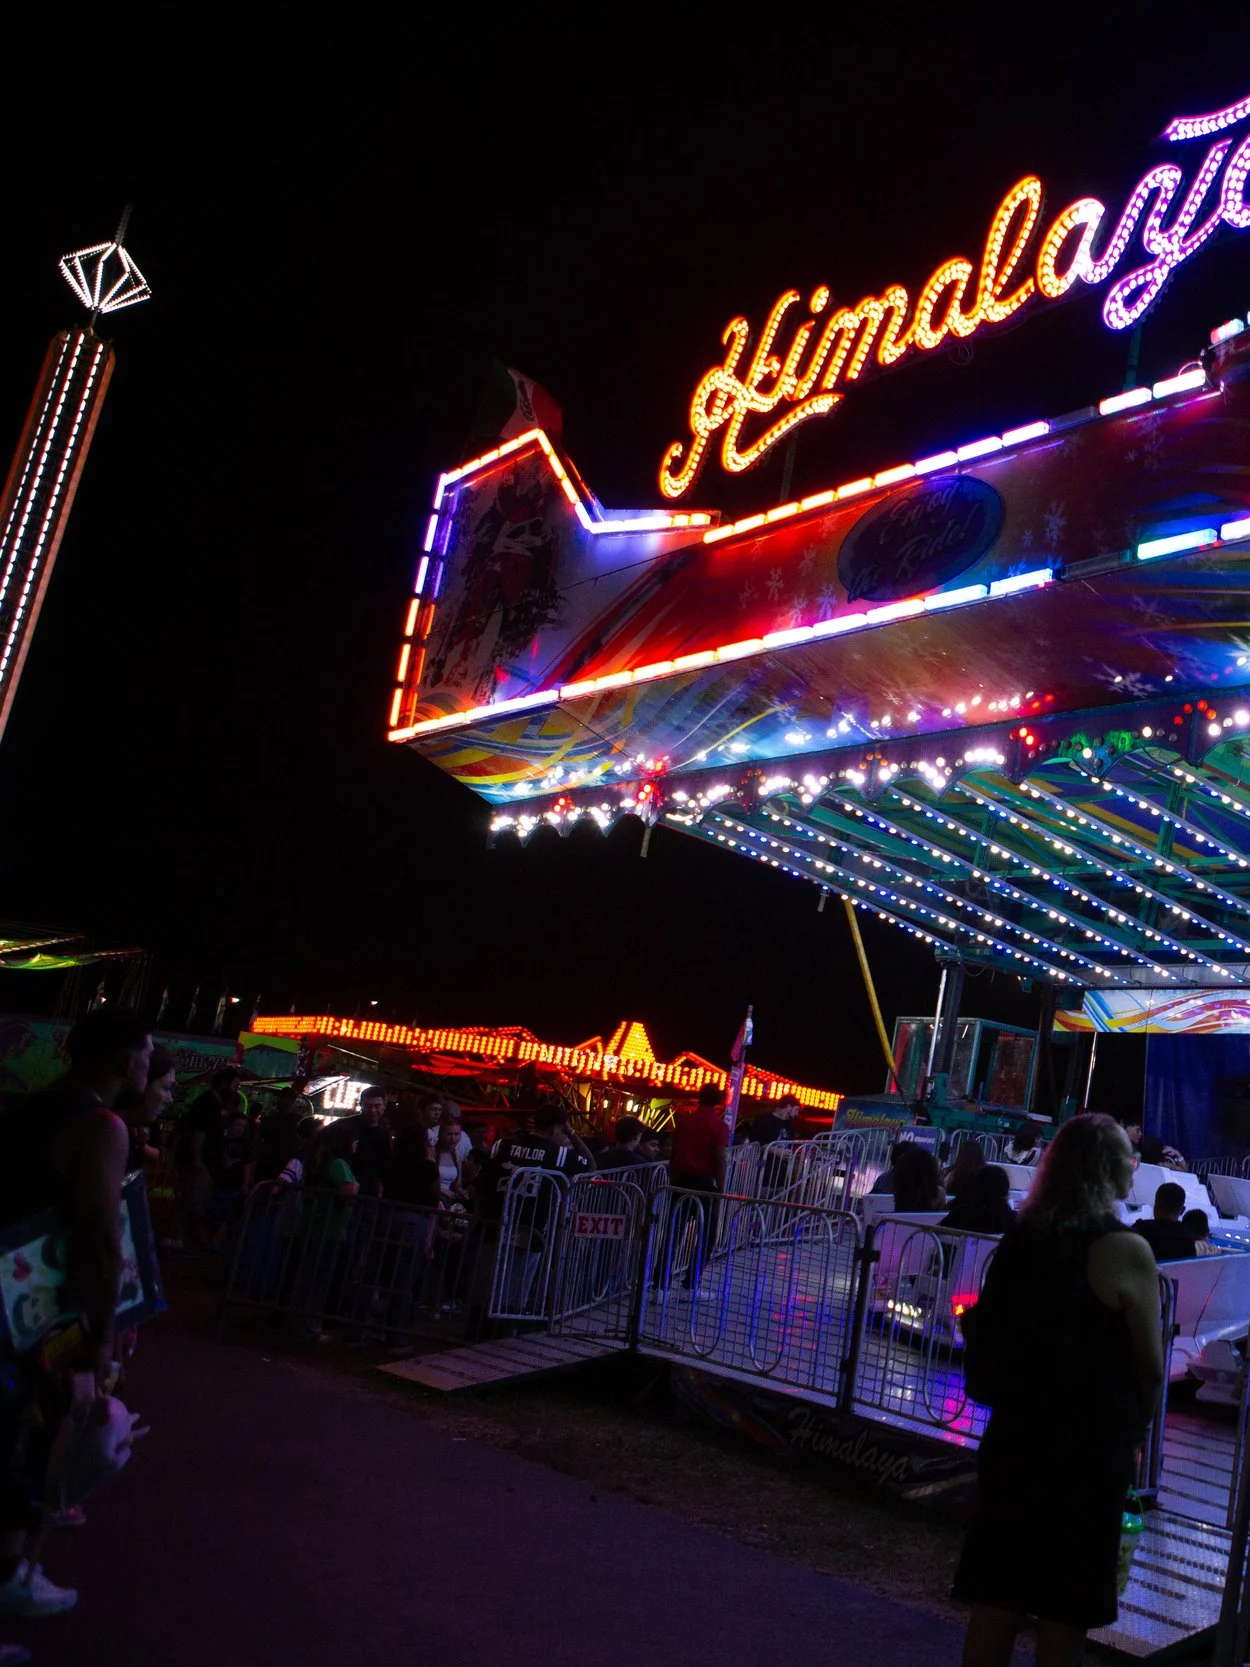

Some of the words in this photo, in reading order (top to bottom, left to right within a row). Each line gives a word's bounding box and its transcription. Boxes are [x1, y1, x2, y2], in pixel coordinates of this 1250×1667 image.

[880, 481, 962, 544] Enjoy
[848, 562, 886, 600] the
[508, 1144, 547, 1162] TAYLOR
[577, 1214, 624, 1236] EXIT
[786, 1405, 911, 1486] Himalaya
